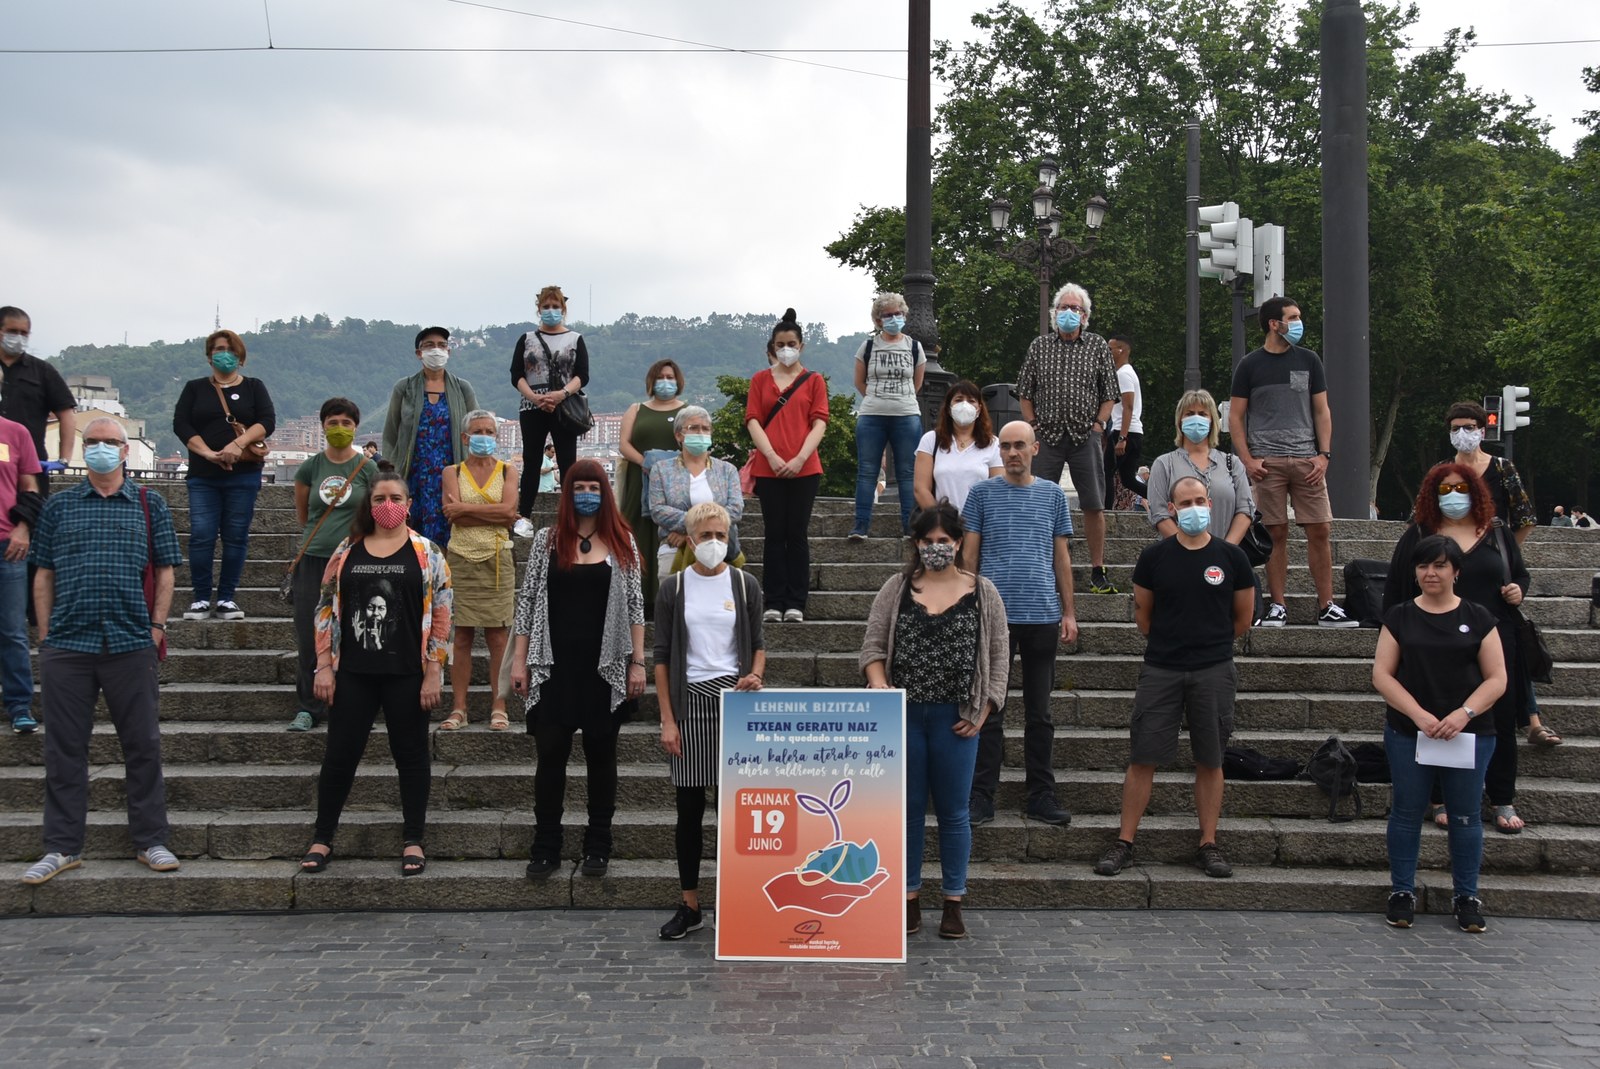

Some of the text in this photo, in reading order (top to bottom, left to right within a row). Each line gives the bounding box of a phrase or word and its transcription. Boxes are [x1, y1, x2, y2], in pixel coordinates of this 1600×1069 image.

[879, 353, 910, 368] WAVES
[887, 369, 905, 380] ARE
[754, 701, 870, 713] LEHENIK BIZITZA!
[747, 721, 878, 732] ETXEAN GERATU NAIZ
[755, 733, 870, 744] Me he quedado en casa
[727, 744, 897, 766] orain kalera aterako gara
[738, 762, 886, 778] ahora saldremos a la calle
[741, 792, 791, 806] EKAINAK
[750, 809, 785, 834] 19
[747, 837, 783, 851] JUNIO
